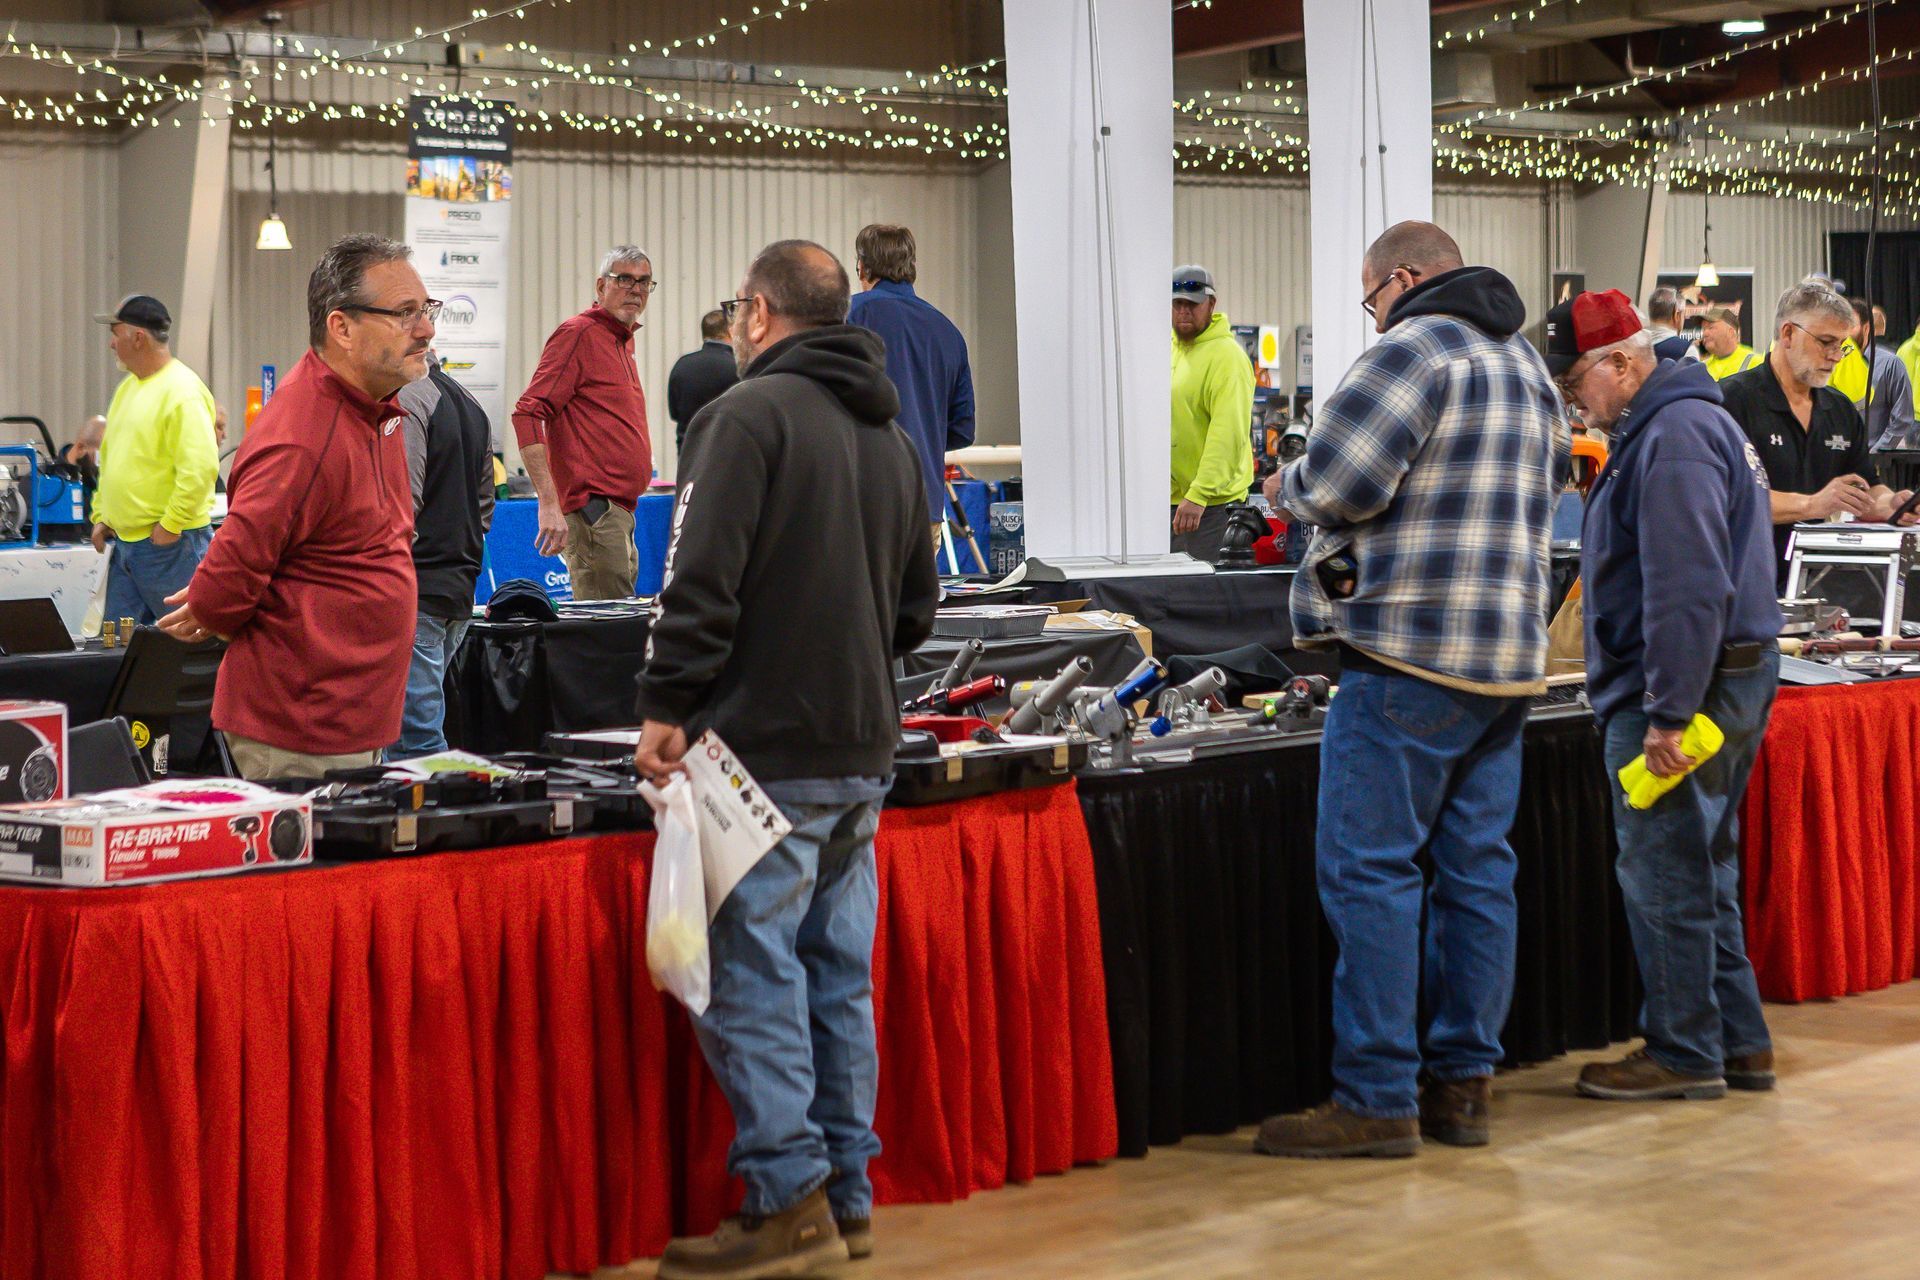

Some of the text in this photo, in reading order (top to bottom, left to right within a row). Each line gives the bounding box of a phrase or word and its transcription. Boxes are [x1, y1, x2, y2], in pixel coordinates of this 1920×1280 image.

[448, 209, 481, 220] PRESCO
[451, 254, 480, 265] FRICK
[442, 307, 474, 325] Rhino
[1001, 515, 1023, 524] BUSCH
[65, 829, 92, 843] MAX
